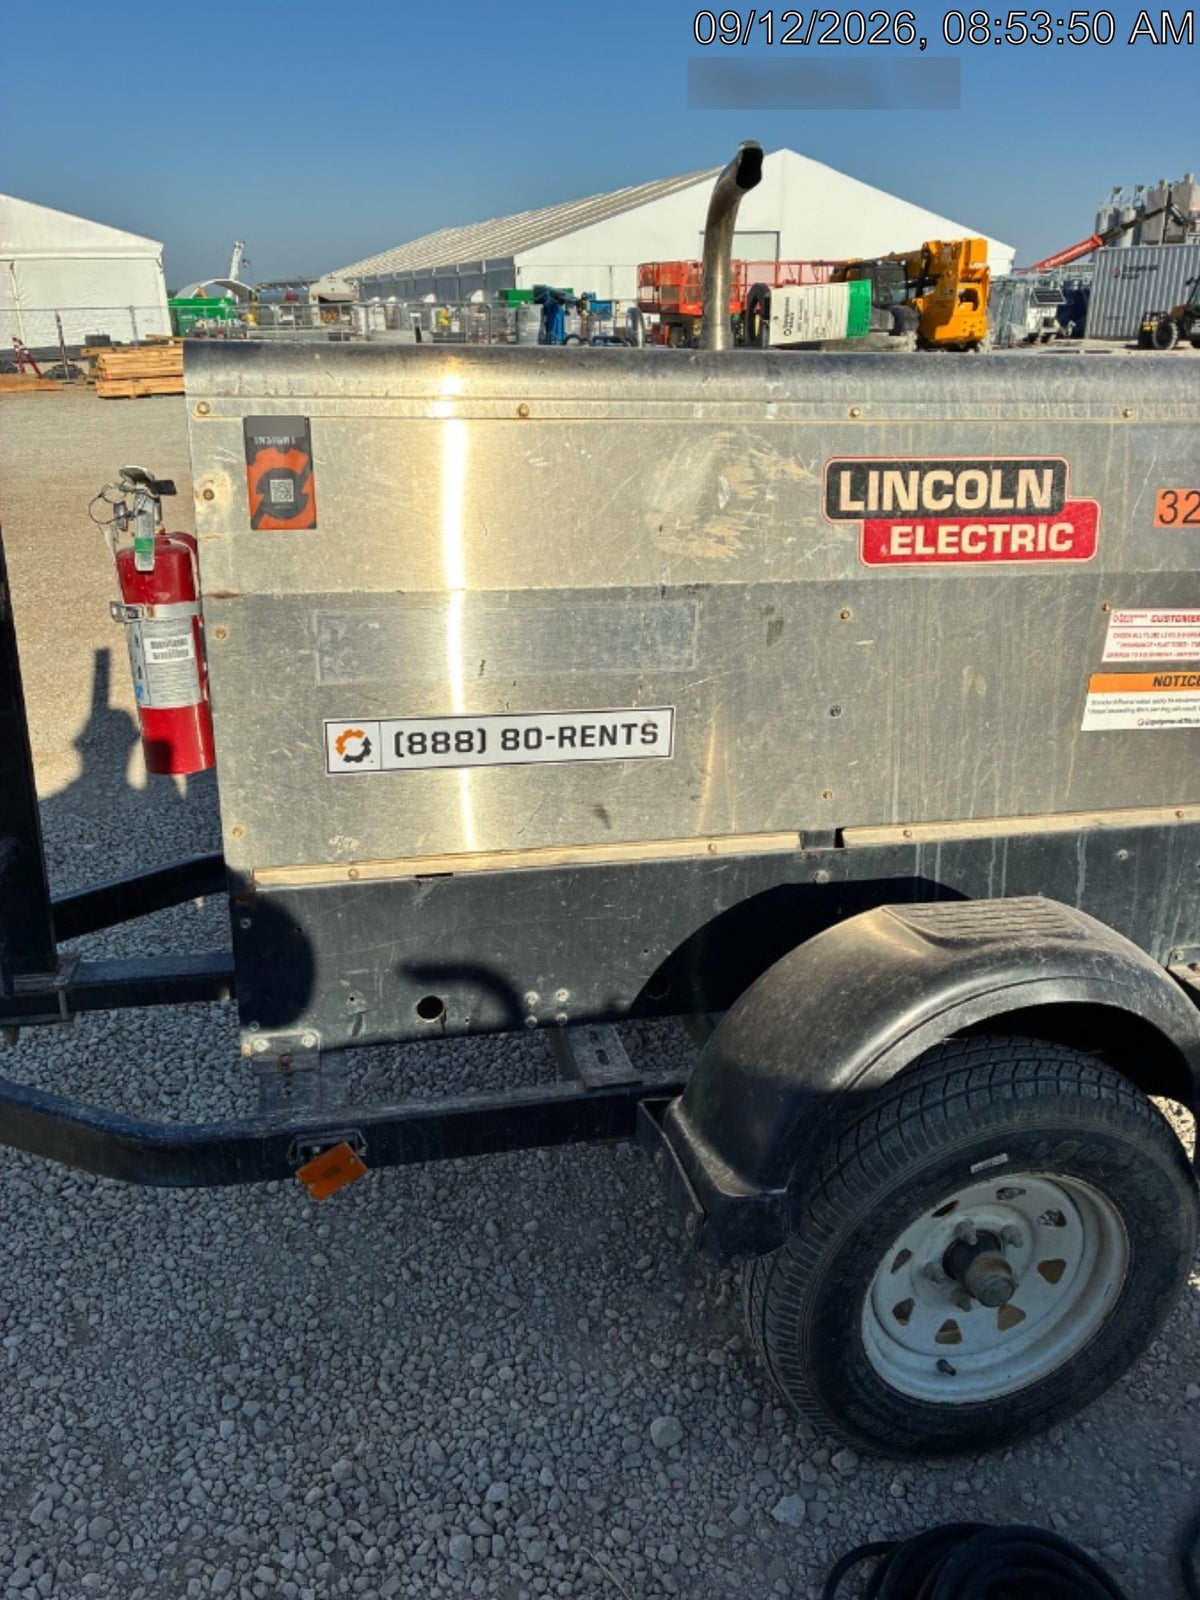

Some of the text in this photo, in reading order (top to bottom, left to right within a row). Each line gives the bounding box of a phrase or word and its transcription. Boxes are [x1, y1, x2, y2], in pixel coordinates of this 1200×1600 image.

[839, 469, 1054, 511] LINCOLN
[1159, 490, 1200, 525] 32
[890, 522, 1075, 555] ELECTRIC
[394, 722, 659, 758] (888) 80-RENTS
